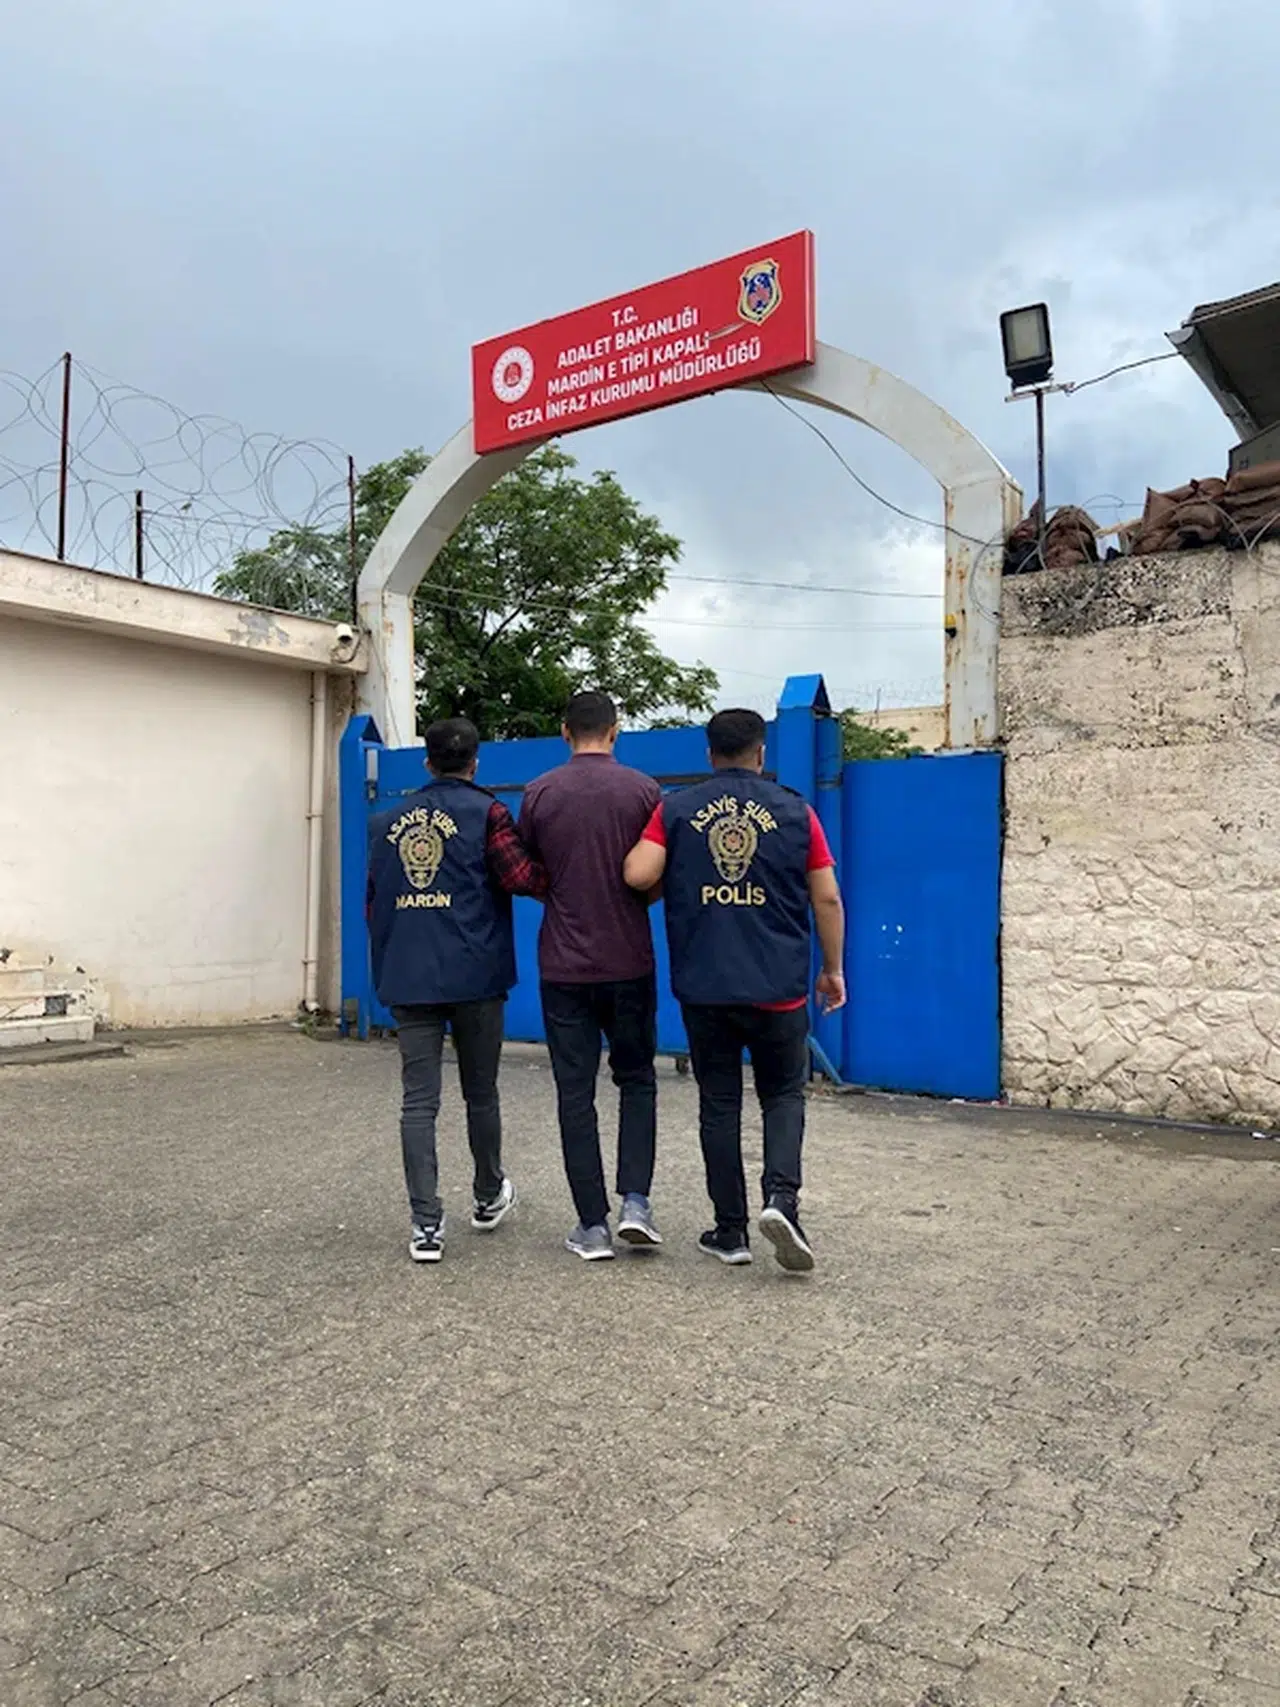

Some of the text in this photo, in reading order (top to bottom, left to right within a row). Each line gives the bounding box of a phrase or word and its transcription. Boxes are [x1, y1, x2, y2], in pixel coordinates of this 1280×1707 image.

[557, 307, 698, 368] ADALET BAKANLIĞI
[611, 307, 639, 327] T.C.
[507, 337, 761, 431] CEZA İNFAZ KURUMU MÜDÜRLÜĞÜ
[547, 363, 604, 396] MARDİN
[608, 361, 618, 379] E
[621, 348, 650, 375] TİPİ
[701, 881, 767, 906] POLİS
